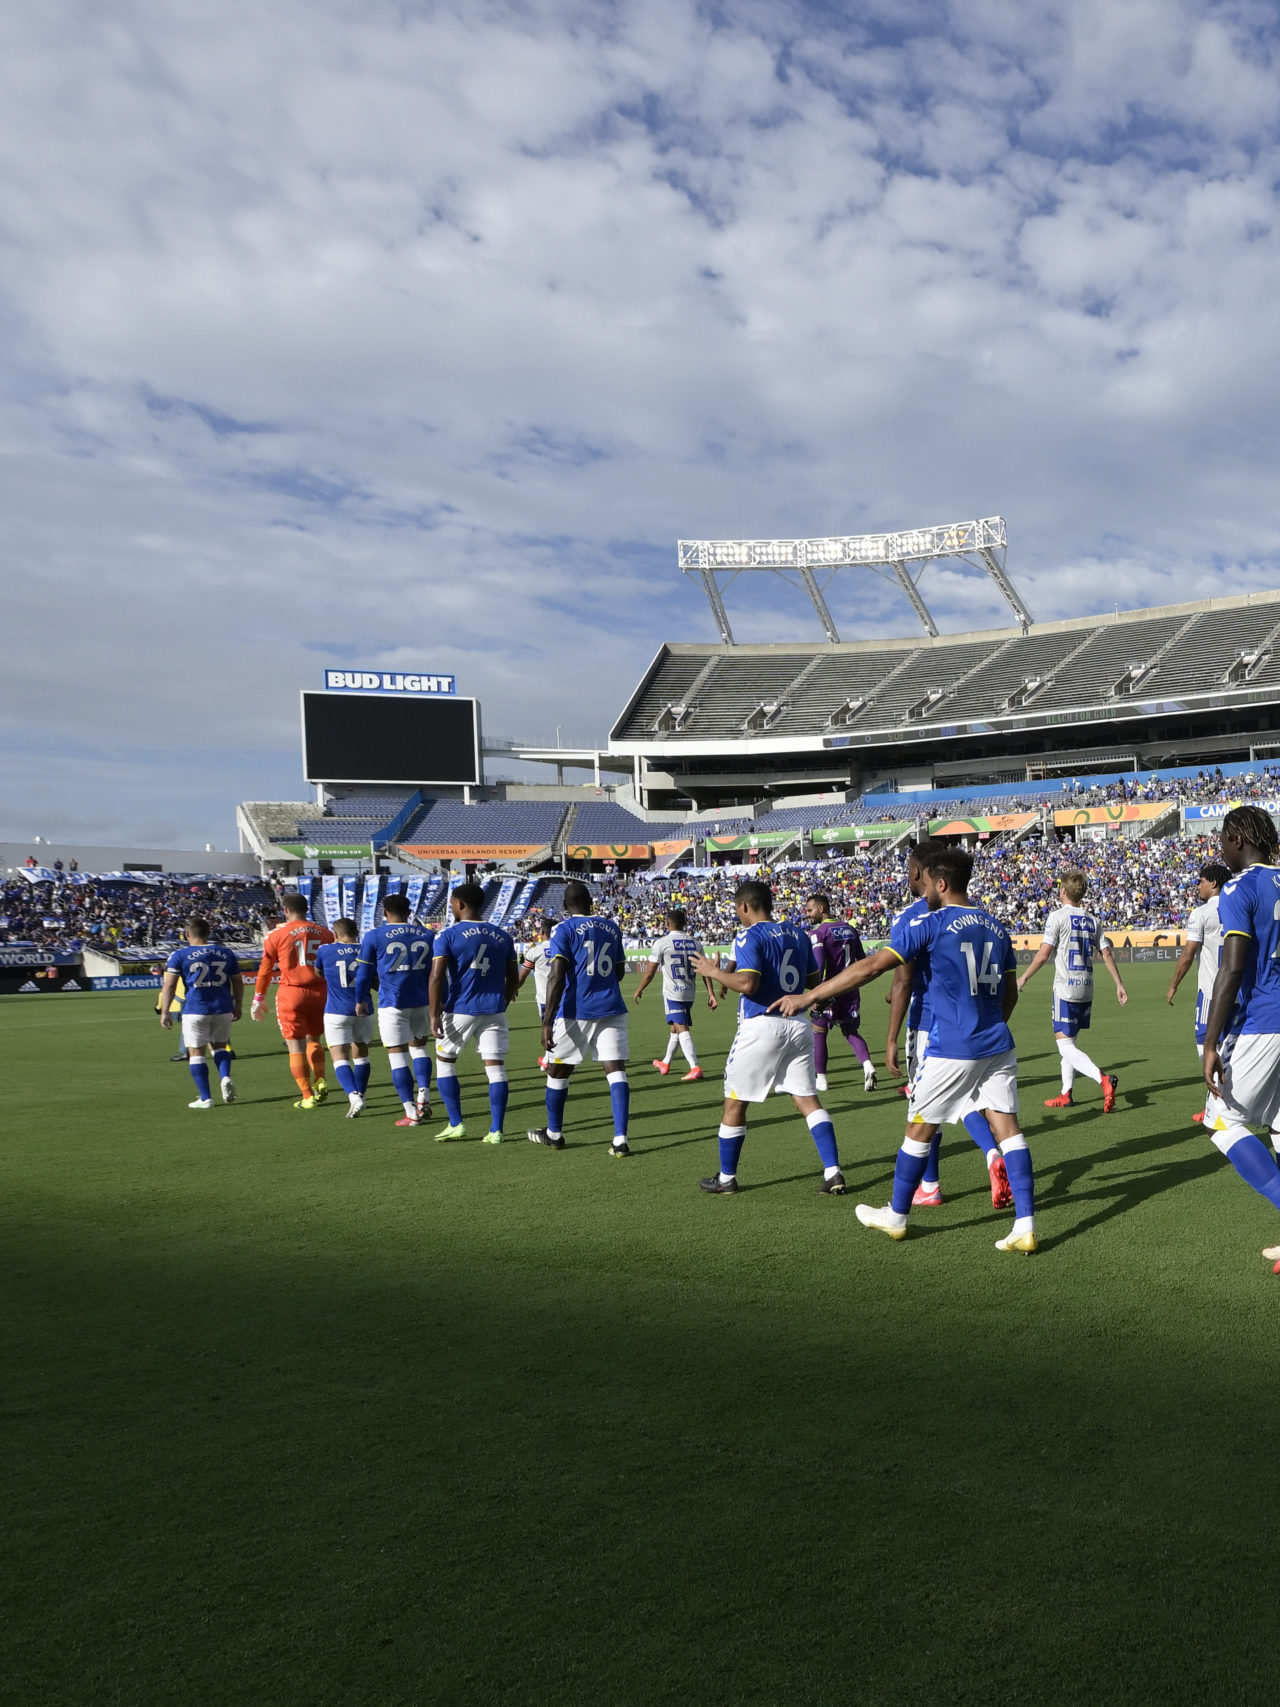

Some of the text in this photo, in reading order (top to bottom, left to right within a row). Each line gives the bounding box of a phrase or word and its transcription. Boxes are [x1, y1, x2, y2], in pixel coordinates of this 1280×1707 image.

[328, 672, 452, 692] BUD LIGHT
[385, 927, 427, 939] GODFREY
[461, 927, 504, 944] HOLGATE
[769, 926, 799, 940] ALLAN
[947, 913, 1004, 940] TOWNSEND
[1, 953, 55, 965] WORLD
[187, 947, 228, 960] COLEMAN
[294, 940, 321, 967] 15
[337, 947, 361, 955] DIGN
[386, 941, 430, 972] 22
[470, 943, 491, 977] 4
[583, 940, 612, 977] 16
[1157, 948, 1171, 958] EL
[190, 961, 228, 988] 23
[779, 949, 800, 992] 6
[960, 942, 1002, 996] 14
